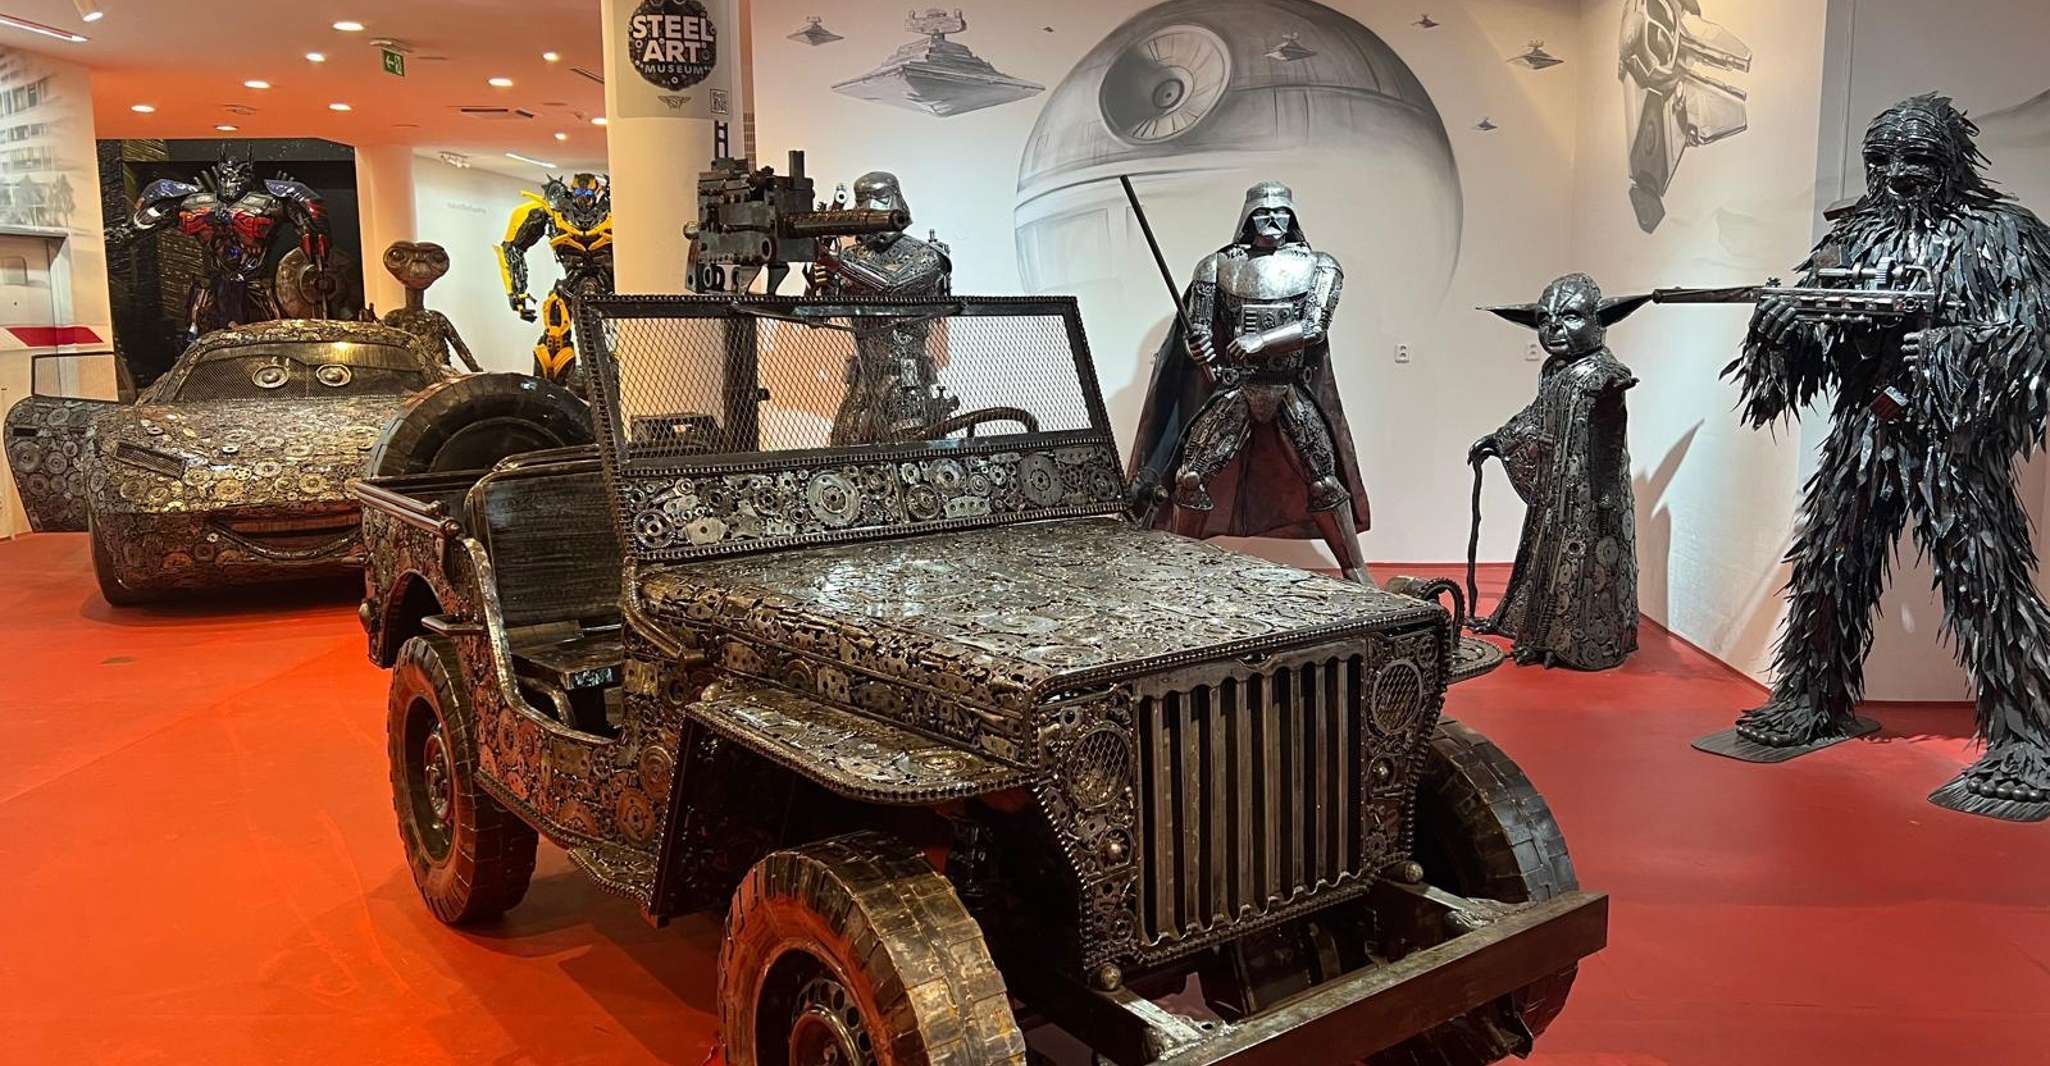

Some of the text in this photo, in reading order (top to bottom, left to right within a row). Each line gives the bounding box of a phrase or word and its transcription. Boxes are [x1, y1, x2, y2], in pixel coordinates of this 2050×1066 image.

[632, 14, 714, 41] STEEL
[642, 39, 701, 63] ART
[644, 64, 704, 75] MUSEUM
